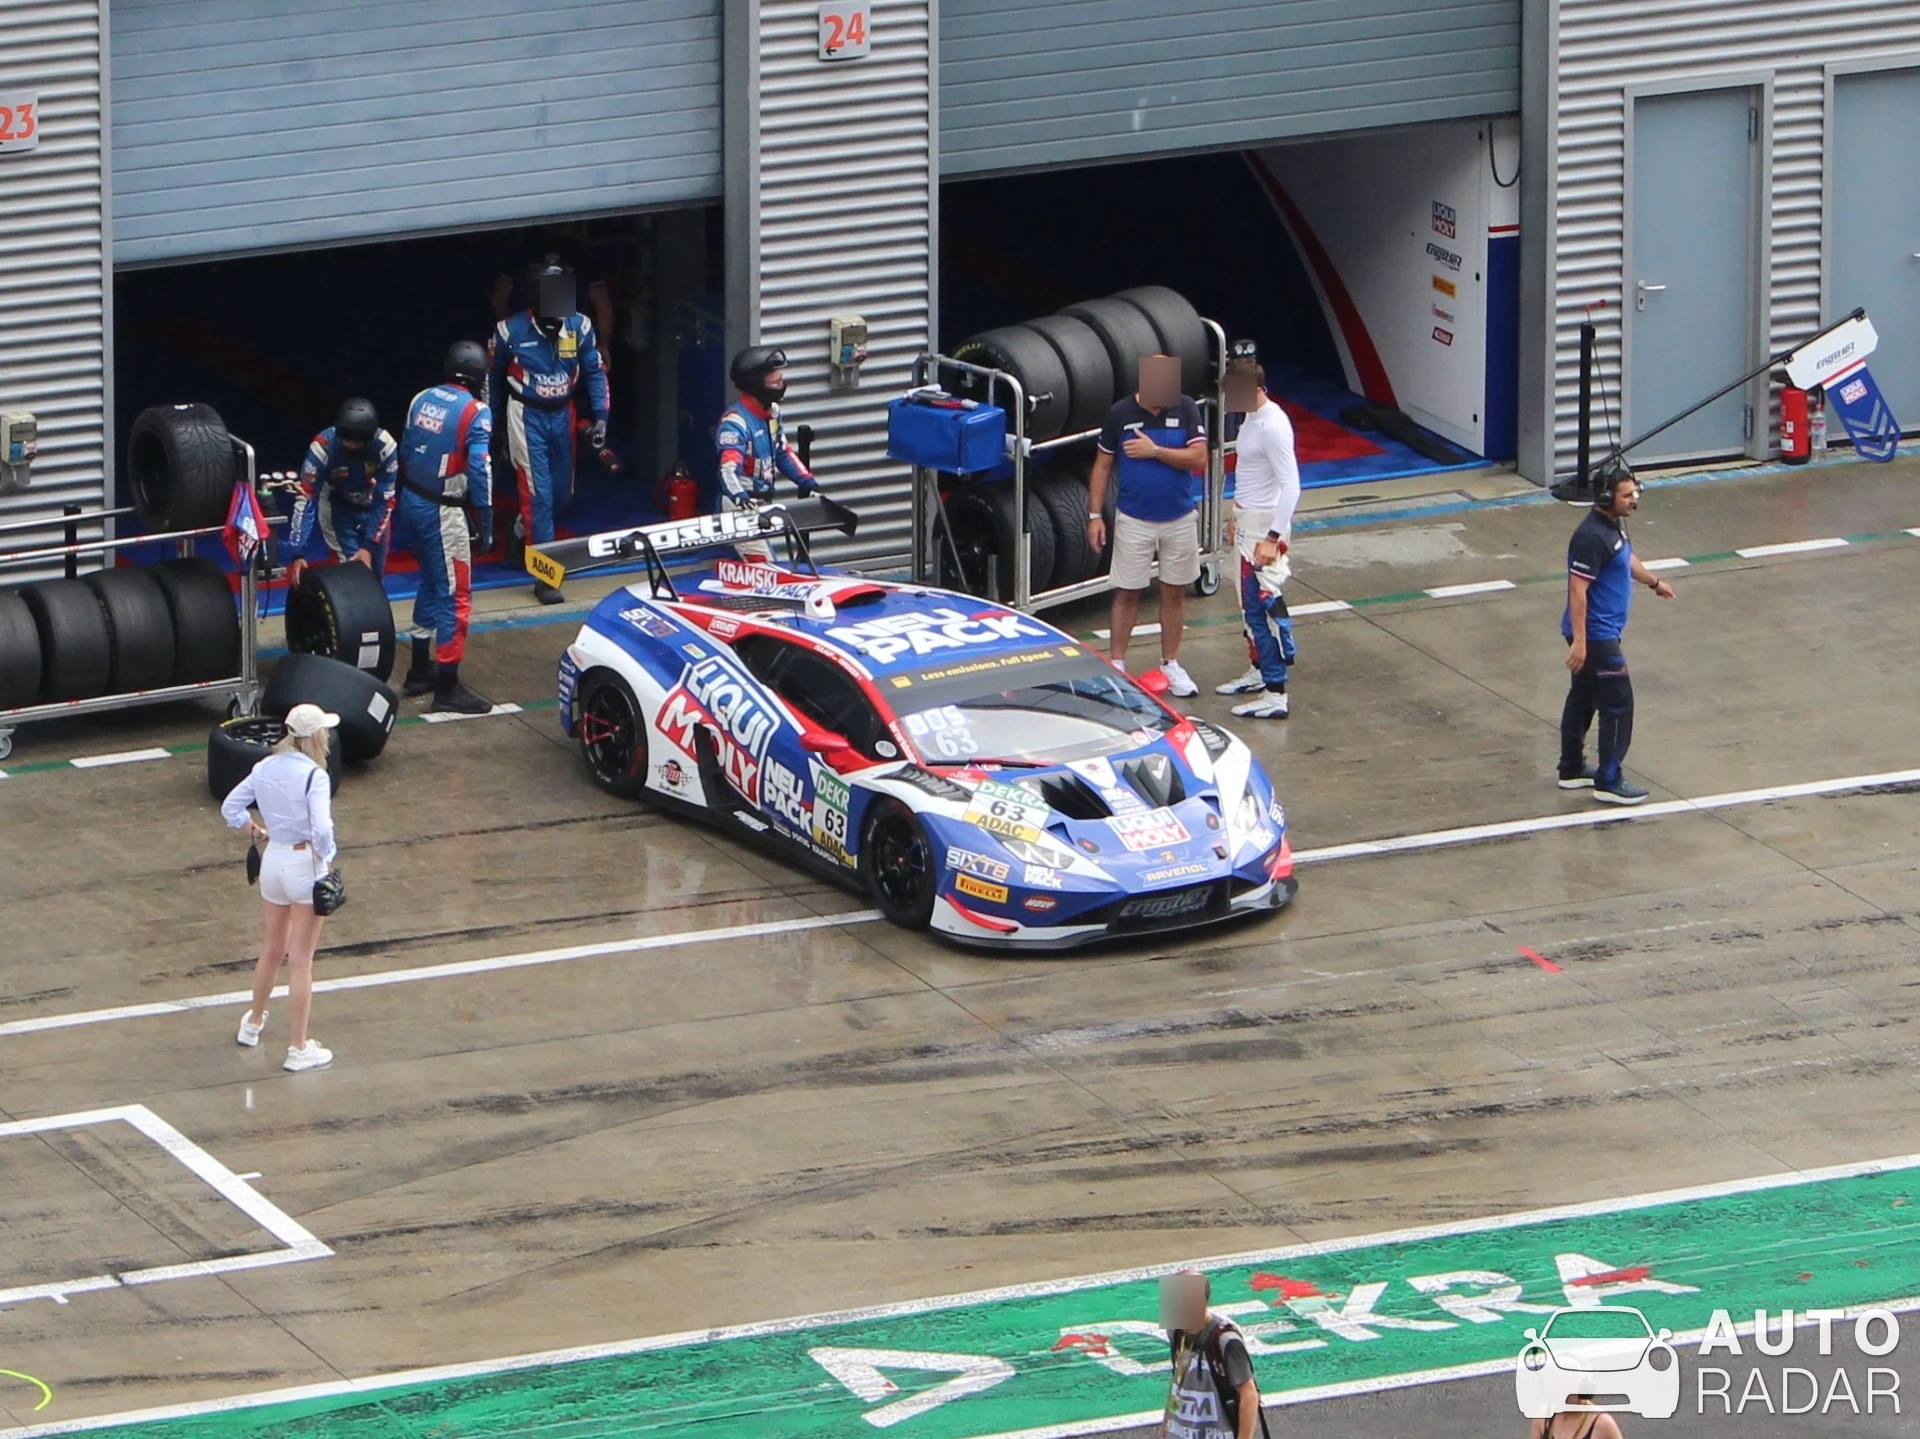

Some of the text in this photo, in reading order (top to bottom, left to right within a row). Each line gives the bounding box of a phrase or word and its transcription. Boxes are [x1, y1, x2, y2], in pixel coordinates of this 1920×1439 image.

[823, 12, 865, 48] 24
[0, 103, 35, 140] 23
[415, 415, 444, 432] MOLY
[420, 402, 449, 420] LIQUI
[718, 561, 778, 588] KRAMSKI
[777, 584, 823, 599] PACK
[824, 608, 968, 645] NEU
[860, 616, 1047, 664] PACK
[921, 670, 946, 681] Less
[1000, 656, 1021, 667] Full
[687, 663, 772, 756] LIQUI
[935, 727, 979, 757] 63
[765, 756, 804, 803] NEU
[764, 778, 813, 836] PACK
[978, 781, 1048, 813] DEKRA
[824, 808, 845, 839] 63
[990, 800, 1026, 822] 63
[1112, 810, 1172, 834] LIQUI
[976, 814, 1024, 837] ADAC
[1124, 825, 1182, 848] MOLY
[1024, 874, 1063, 889] PACK
[1146, 863, 1209, 881] RAVENOL
